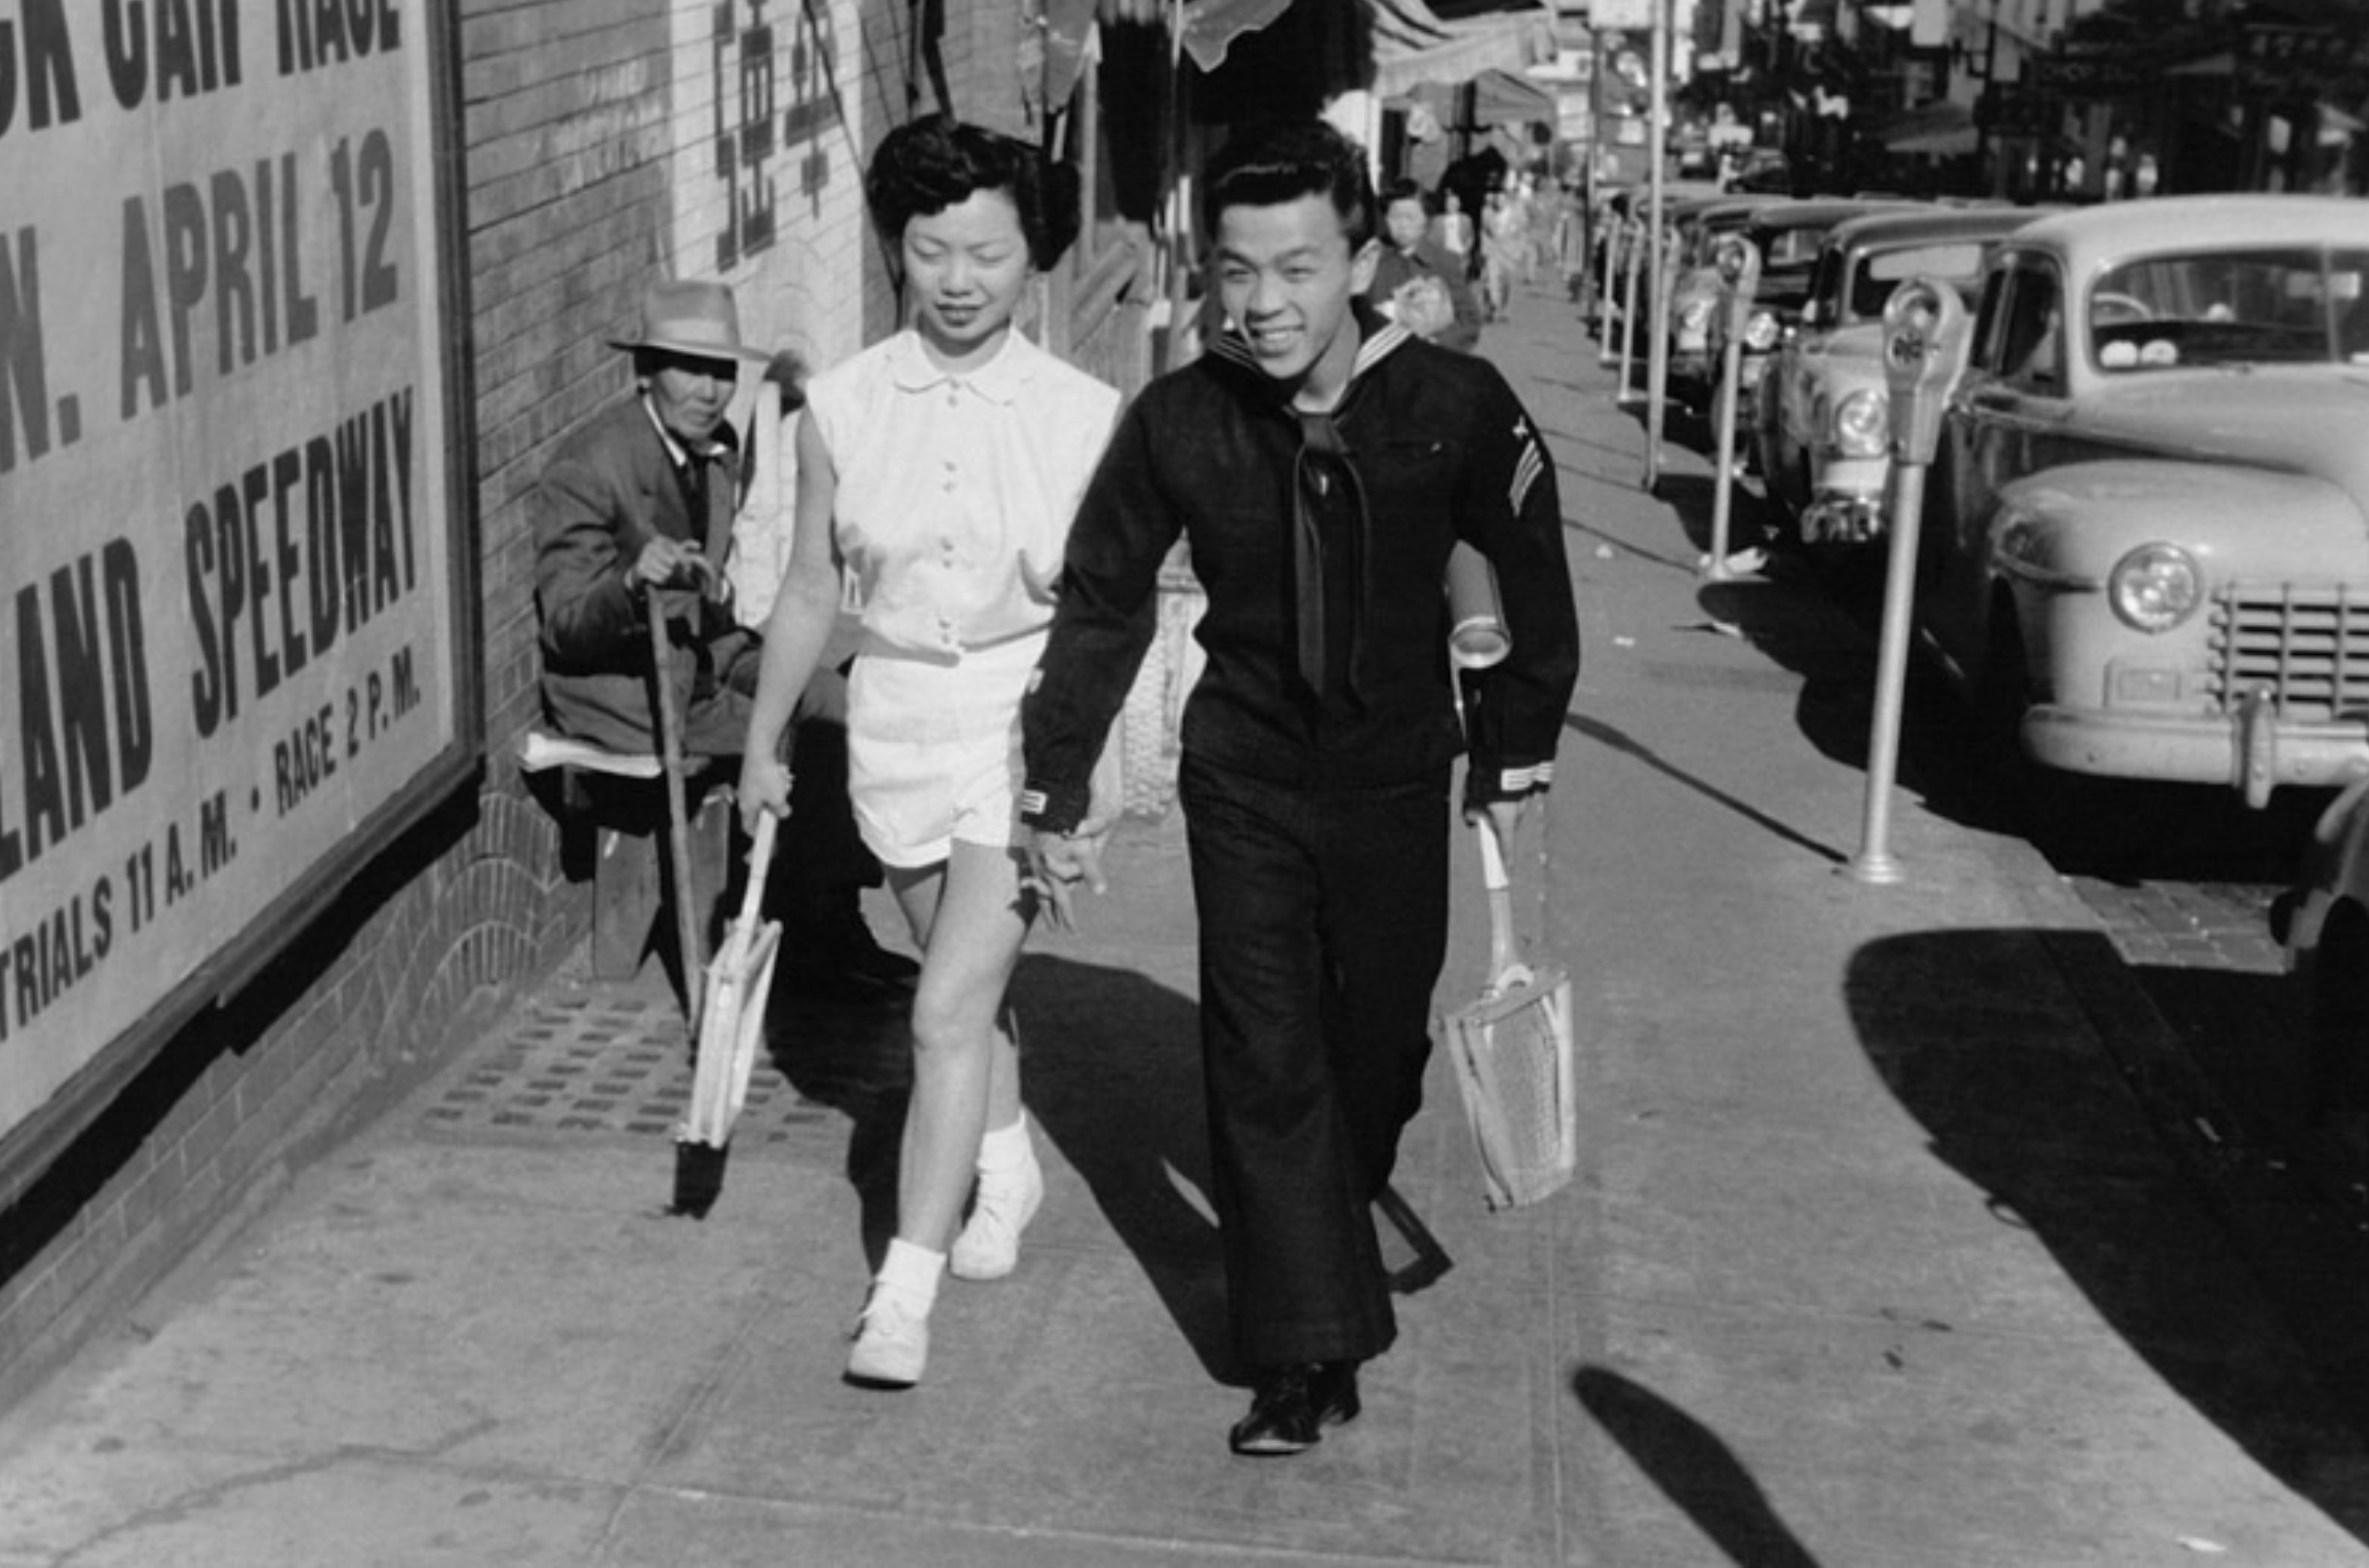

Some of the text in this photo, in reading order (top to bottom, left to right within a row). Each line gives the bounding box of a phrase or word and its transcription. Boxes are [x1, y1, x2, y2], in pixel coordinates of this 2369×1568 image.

[121, 151, 318, 421] APRIL
[331, 128, 397, 324] 12
[0, 385, 415, 884] AND SPEEDWAY
[127, 840, 154, 933] 11
[274, 701, 337, 819] RACE
[346, 685, 361, 760] 2
